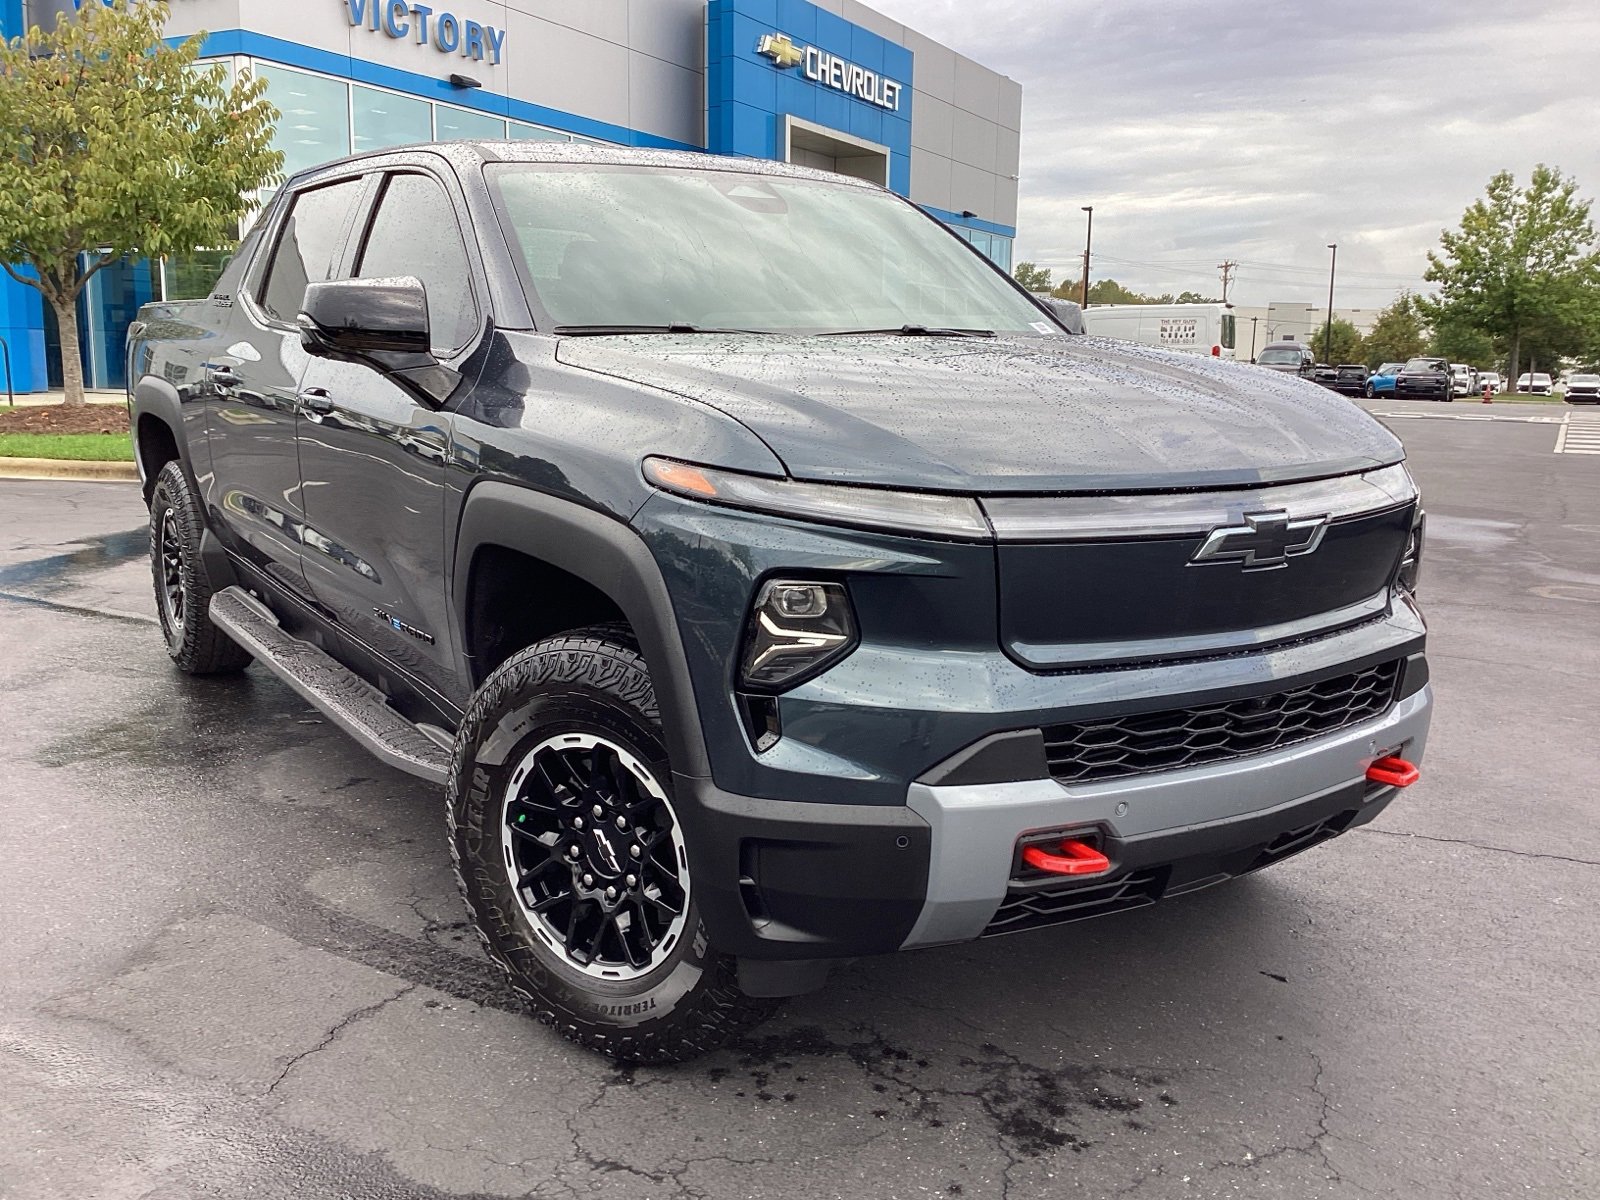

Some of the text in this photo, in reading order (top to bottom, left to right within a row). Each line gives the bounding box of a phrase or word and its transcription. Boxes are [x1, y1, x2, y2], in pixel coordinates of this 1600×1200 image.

[345, 0, 505, 65] VICTORY
[805, 46, 902, 112] CHEVROLET
[584, 997, 656, 1017] TERRITOR
